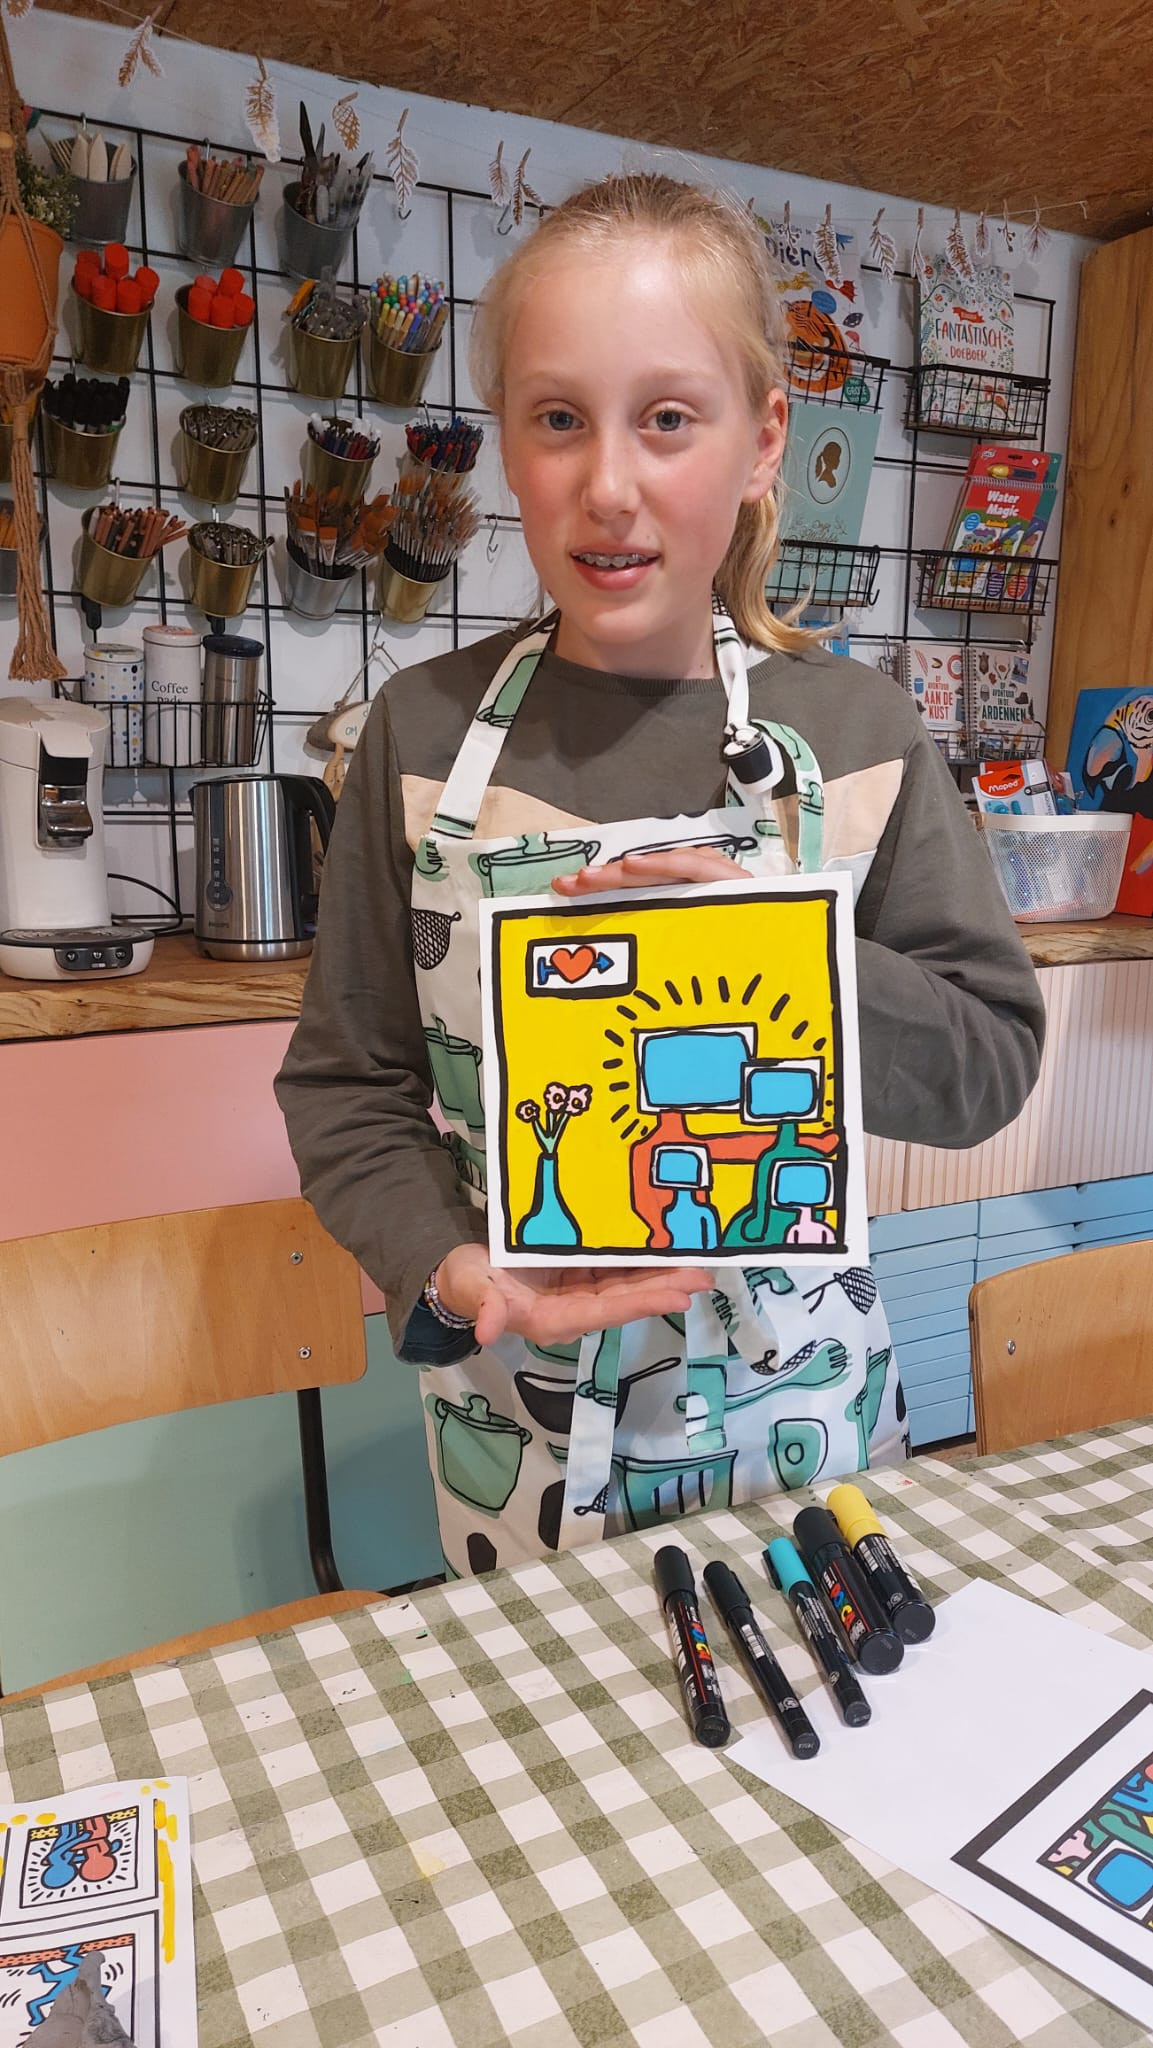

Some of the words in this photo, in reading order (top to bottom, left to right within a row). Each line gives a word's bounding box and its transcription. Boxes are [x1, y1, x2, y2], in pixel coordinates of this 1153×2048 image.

[936, 319, 1002, 349] FANTASTISCH
[950, 345, 987, 361] DOEBOEK
[987, 490, 1020, 504] Water
[986, 504, 1019, 518] Magic
[151, 680, 189, 694] Coffee
[992, 689, 1015, 698] AVONTUUR
[924, 691, 943, 705] AAN
[943, 692, 953, 706] DE
[929, 705, 949, 720] KUST
[982, 705, 1026, 722] ARDENNEN
[988, 780, 1019, 793] Maped
